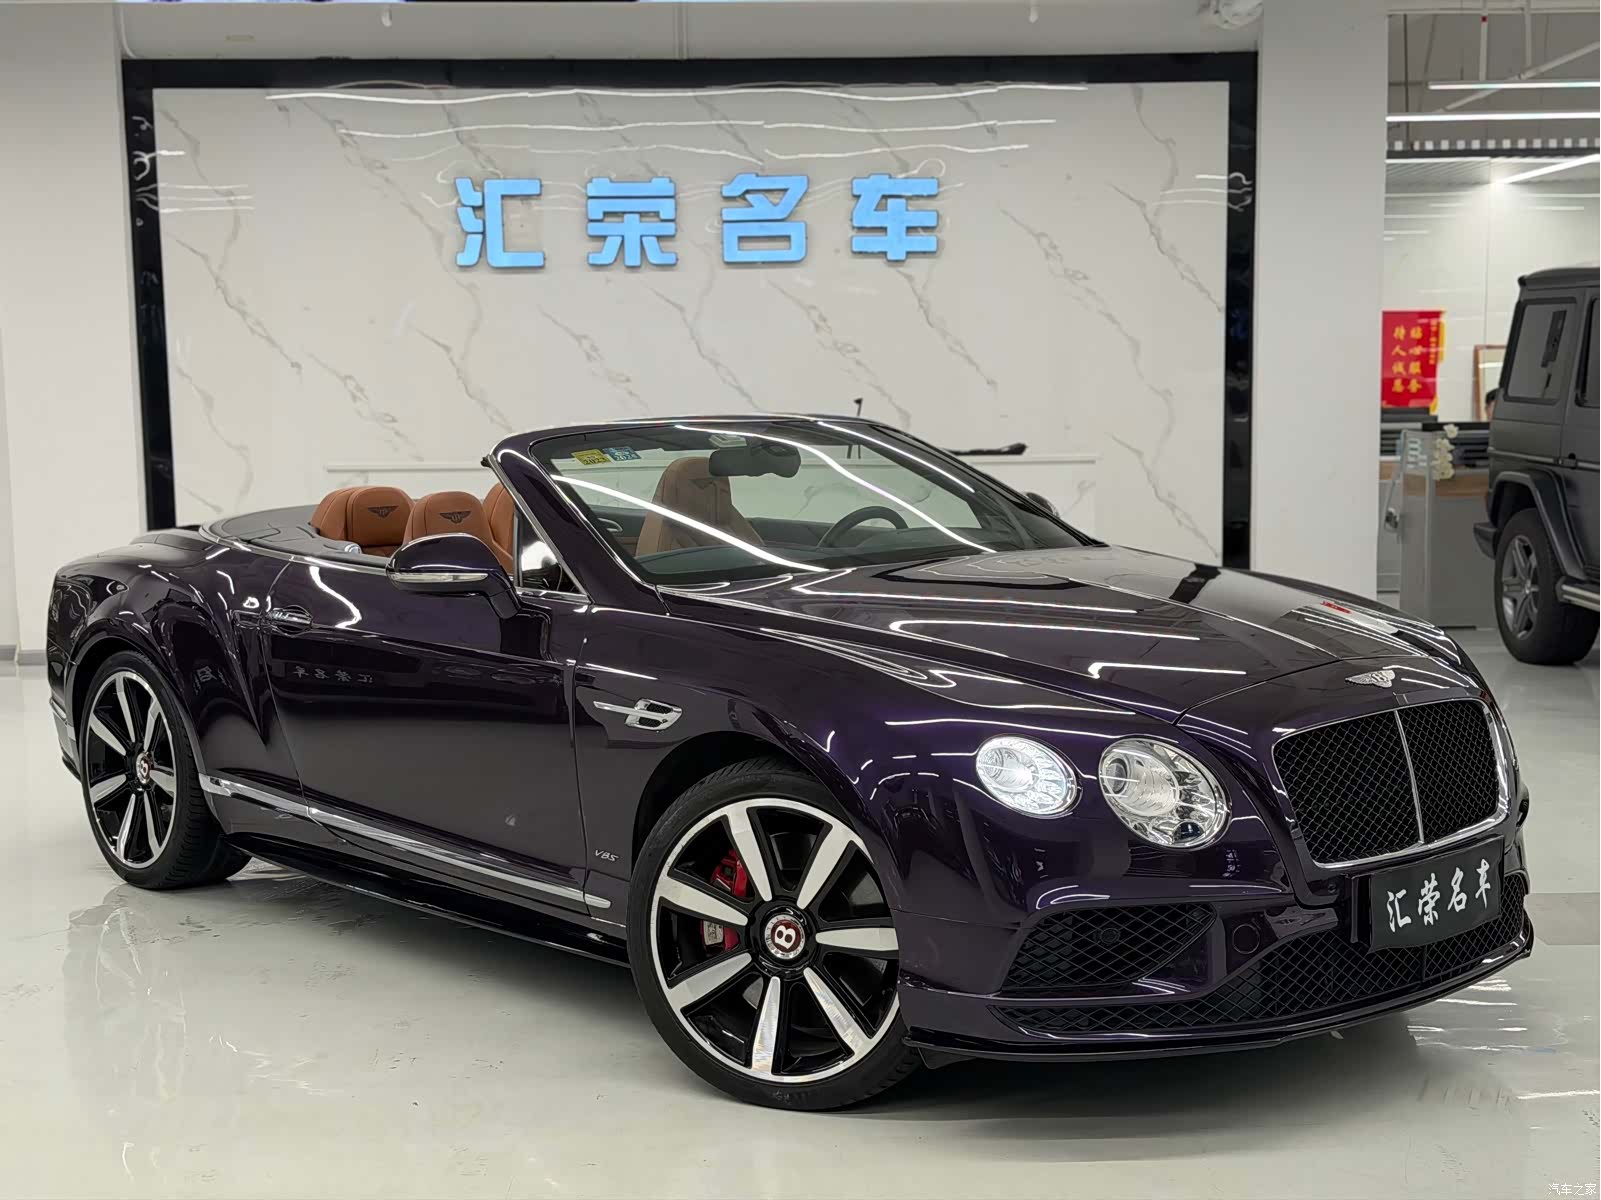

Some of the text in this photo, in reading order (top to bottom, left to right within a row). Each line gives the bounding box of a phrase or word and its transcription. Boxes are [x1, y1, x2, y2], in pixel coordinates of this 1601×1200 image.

[455, 173, 938, 267] 汇荣名车
[595, 850, 619, 861] V8S
[1387, 858, 1491, 933] 汇荣名车
